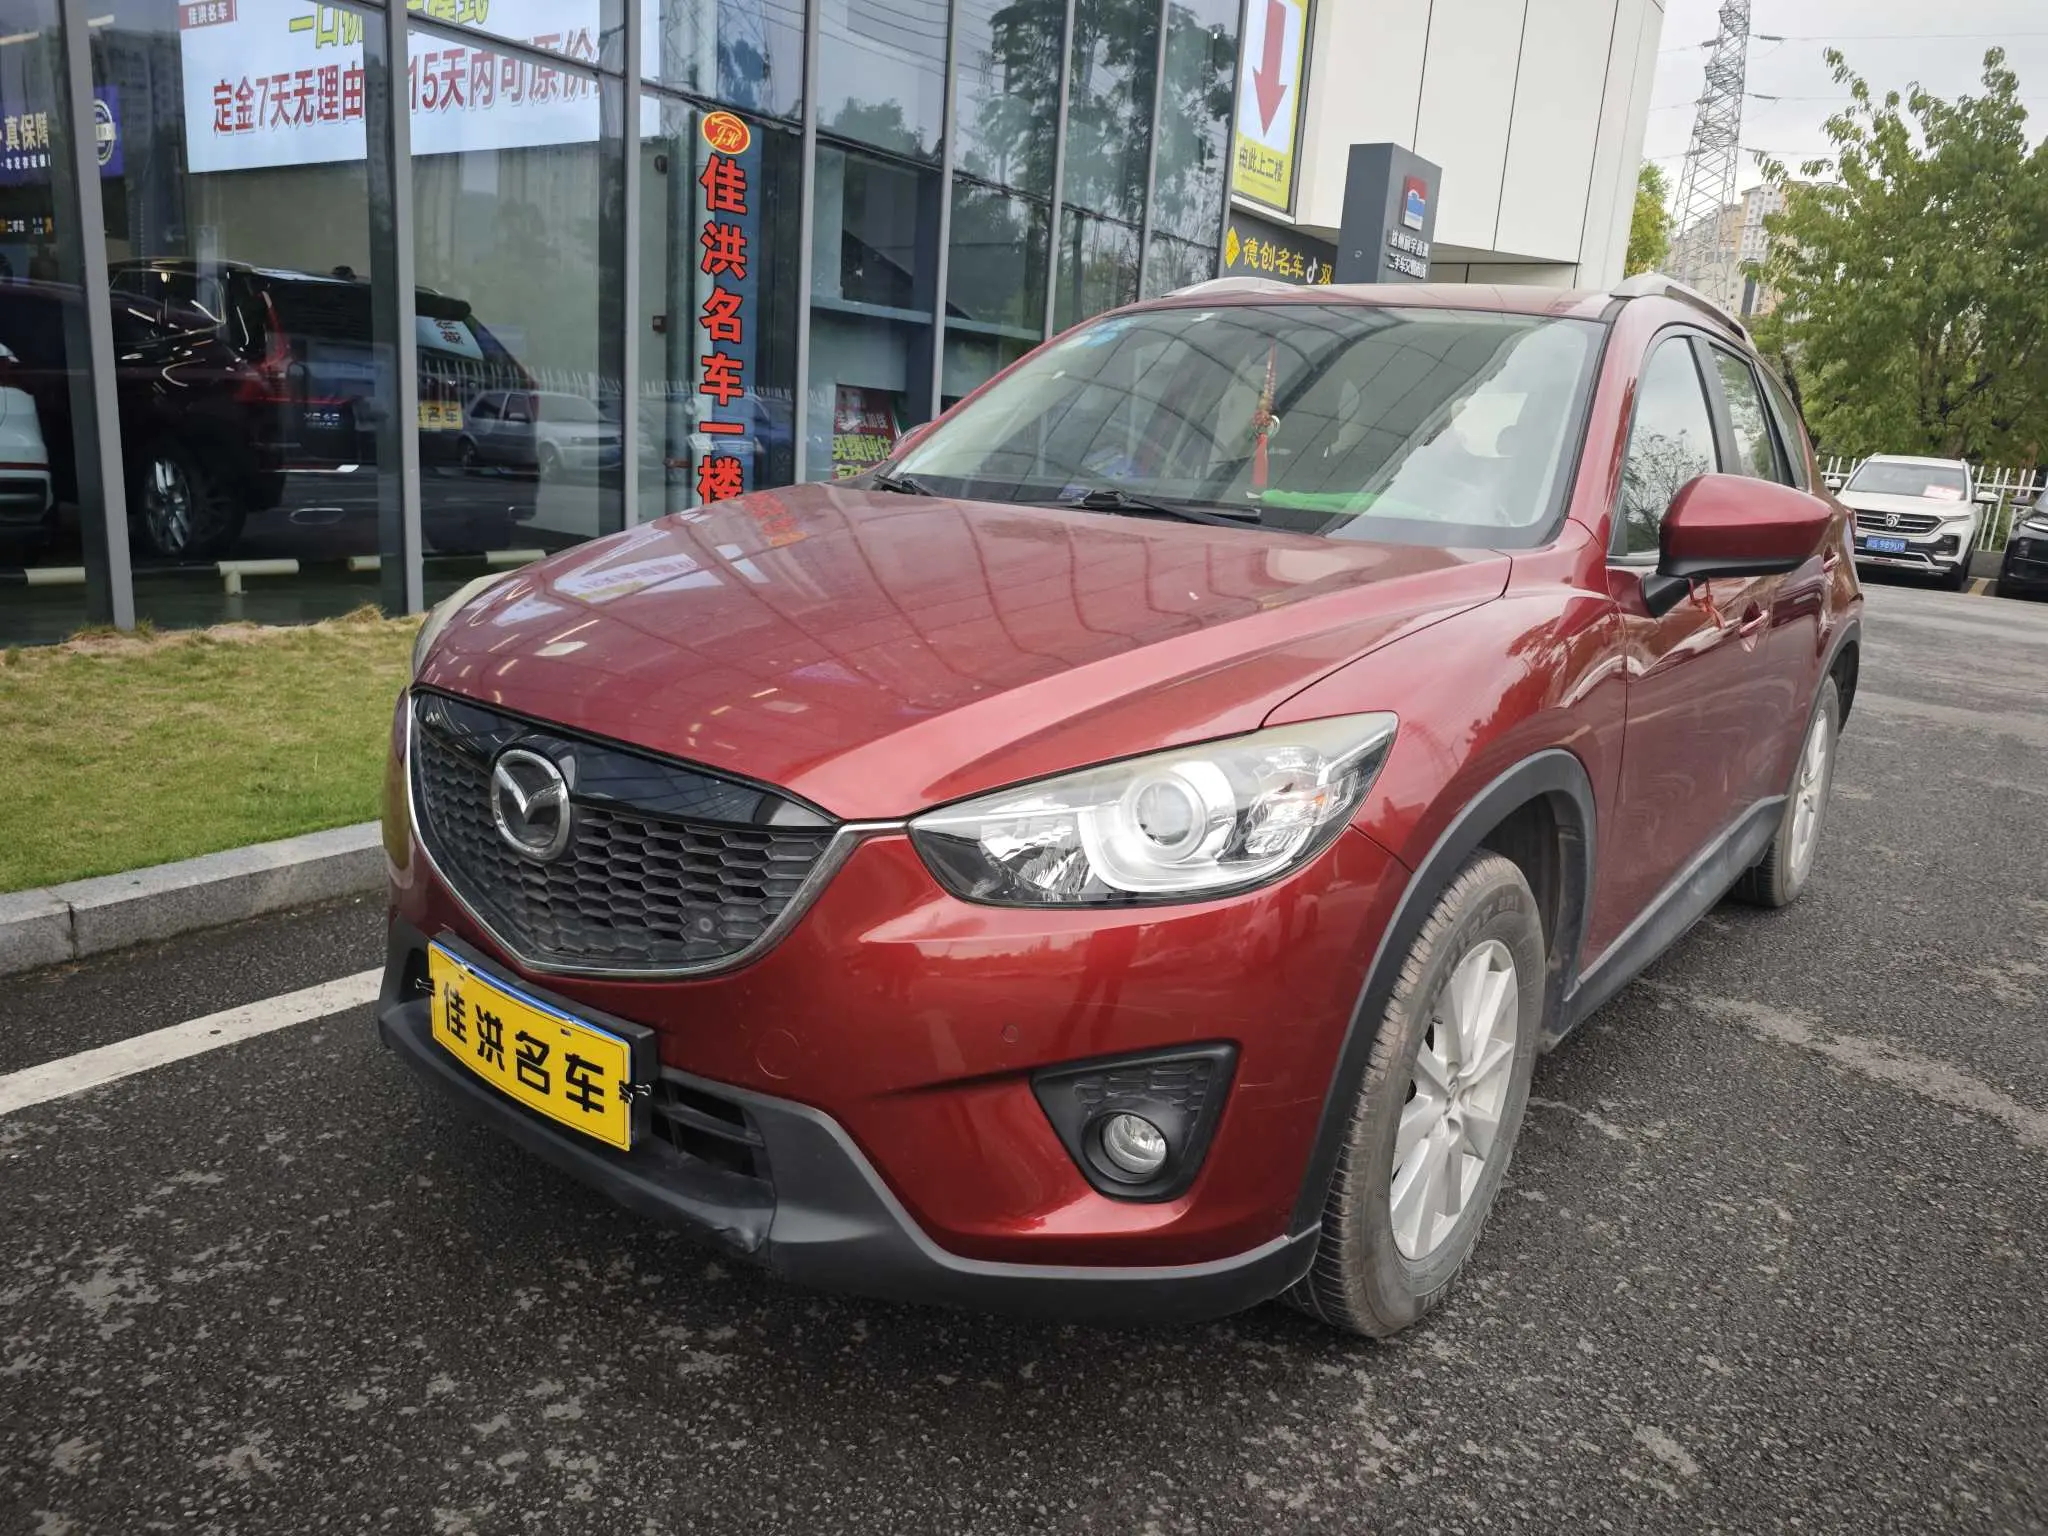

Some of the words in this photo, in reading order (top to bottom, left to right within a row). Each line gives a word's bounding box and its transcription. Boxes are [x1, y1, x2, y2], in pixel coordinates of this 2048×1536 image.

[188, 2, 228, 26] 佳洪名车
[213, 61, 365, 133] 定金7天无理由
[1243, 237, 1304, 280] 德创名车
[697, 153, 748, 505] 佳洪名车一楼
[442, 981, 605, 1114] 佳洪名车
